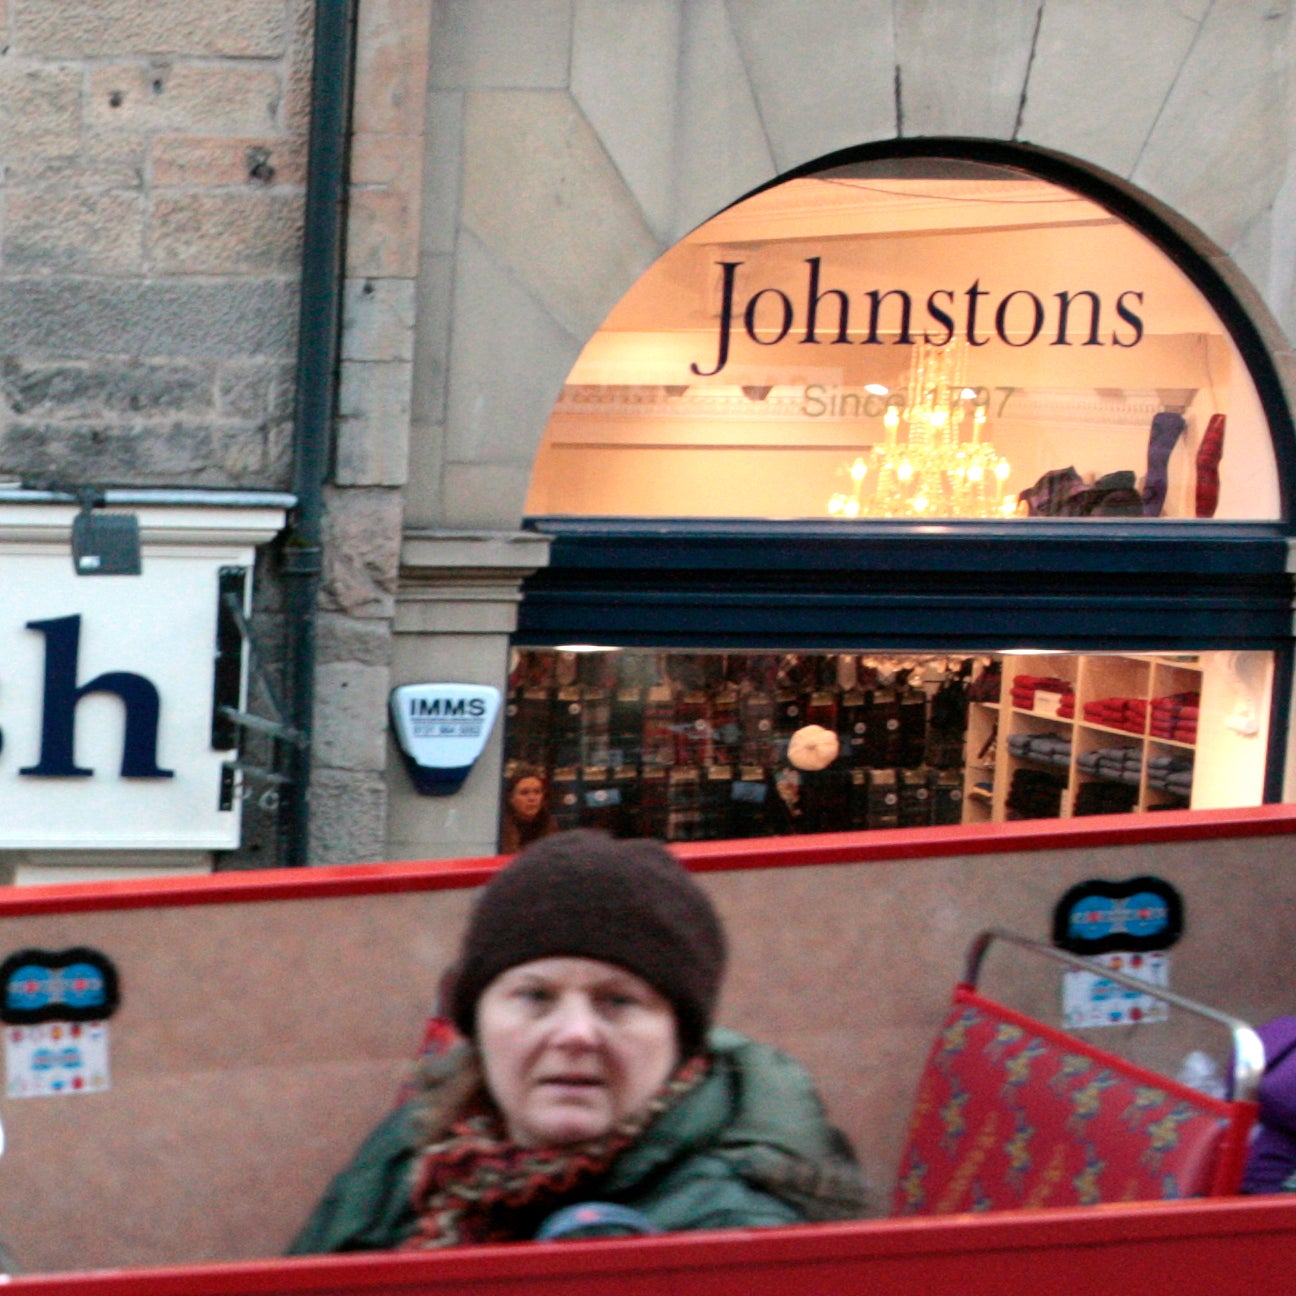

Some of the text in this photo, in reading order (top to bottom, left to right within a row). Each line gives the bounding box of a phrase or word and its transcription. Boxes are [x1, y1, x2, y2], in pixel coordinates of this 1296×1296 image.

[690, 256, 1145, 376] Johnstons
[802, 383, 904, 418] Since
[410, 698, 486, 716] IMMS
